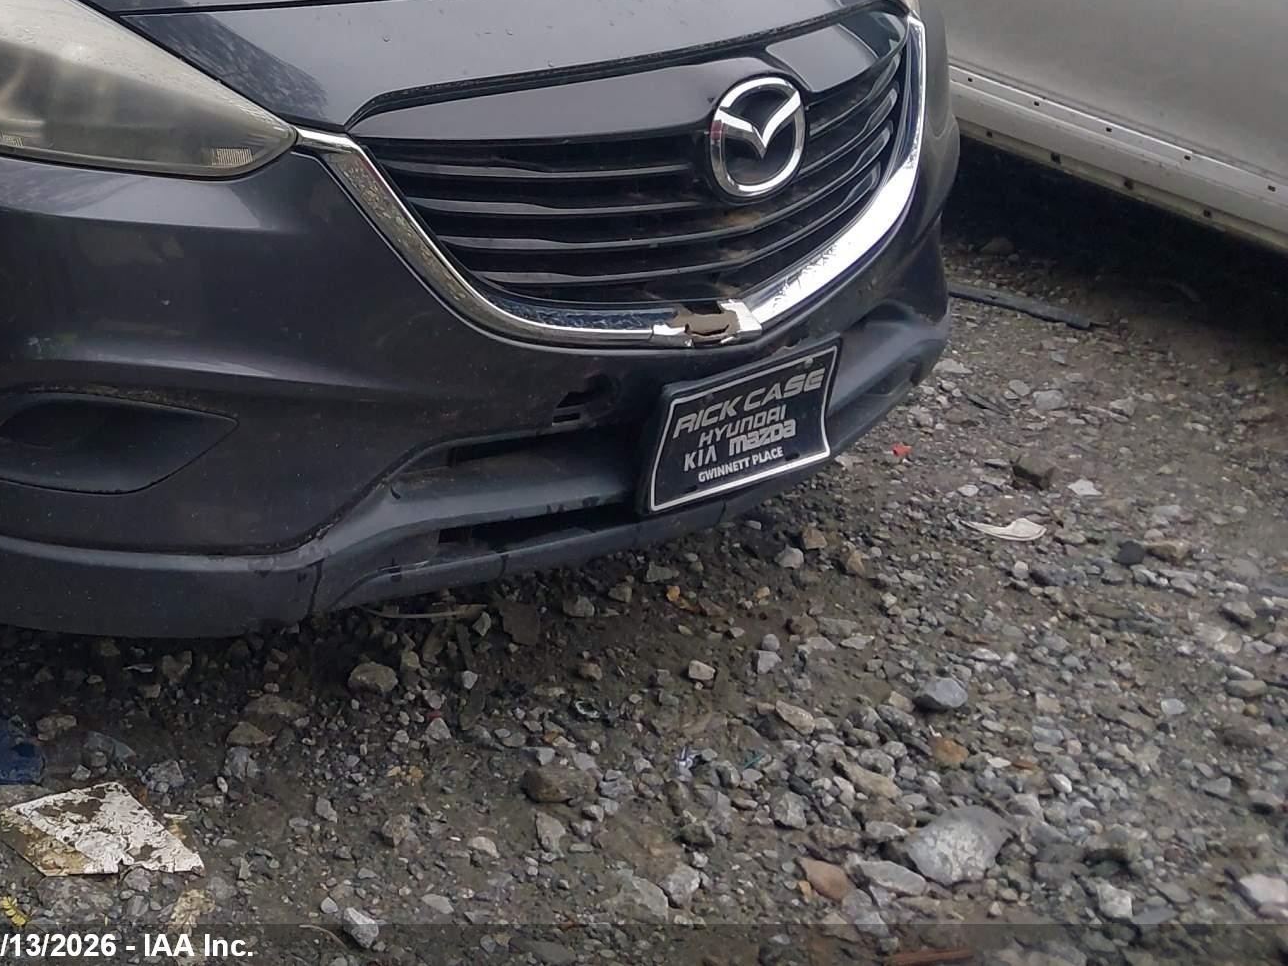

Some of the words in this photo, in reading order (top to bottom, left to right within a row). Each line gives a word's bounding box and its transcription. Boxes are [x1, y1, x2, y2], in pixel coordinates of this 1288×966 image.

[672, 395, 743, 439] RICK
[743, 367, 825, 412] CASE
[698, 404, 787, 448] HYUNDAI
[683, 445, 718, 472] KIA
[698, 458, 752, 483] GWINNETT
[752, 446, 784, 466] PLACE
